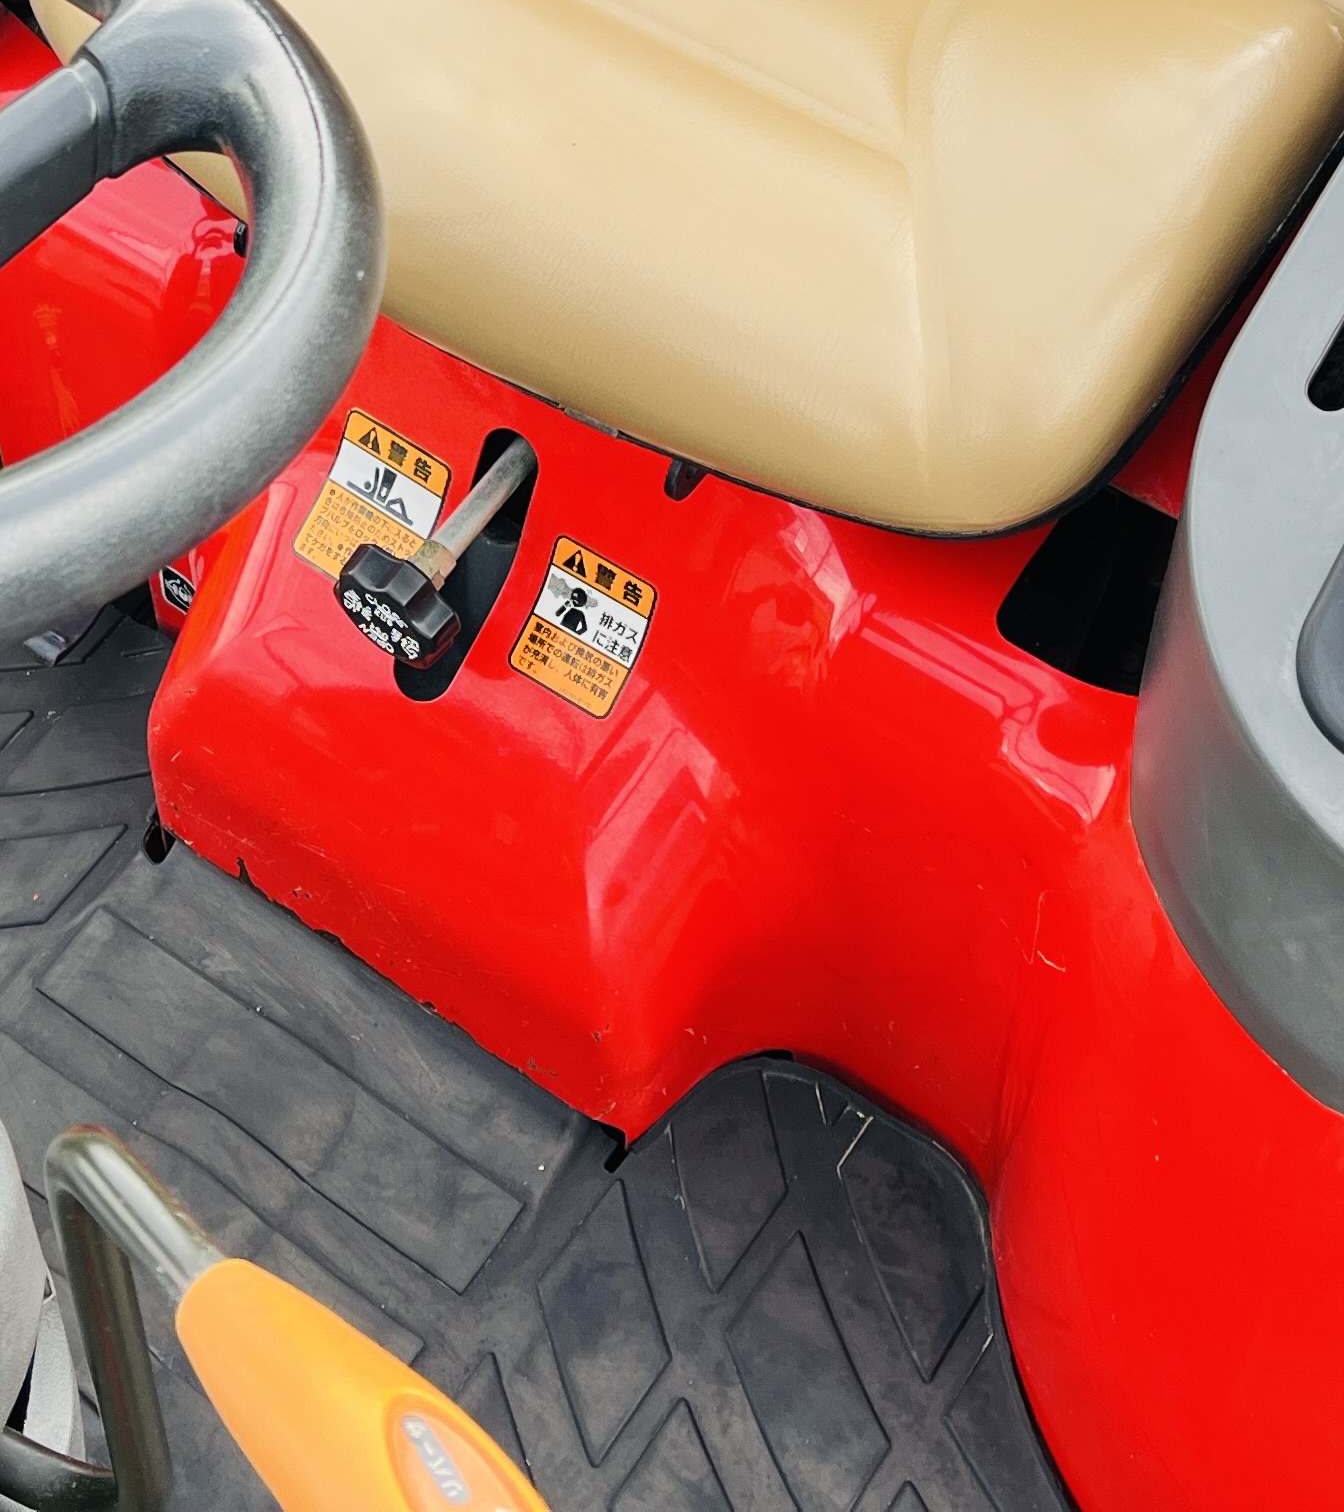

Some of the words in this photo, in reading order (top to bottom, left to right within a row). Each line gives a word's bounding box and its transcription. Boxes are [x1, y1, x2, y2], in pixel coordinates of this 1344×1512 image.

[387, 439, 432, 485] 警告
[595, 562, 644, 607] 警告
[591, 629, 634, 664] に注意
[599, 611, 639, 644] 排ガス
